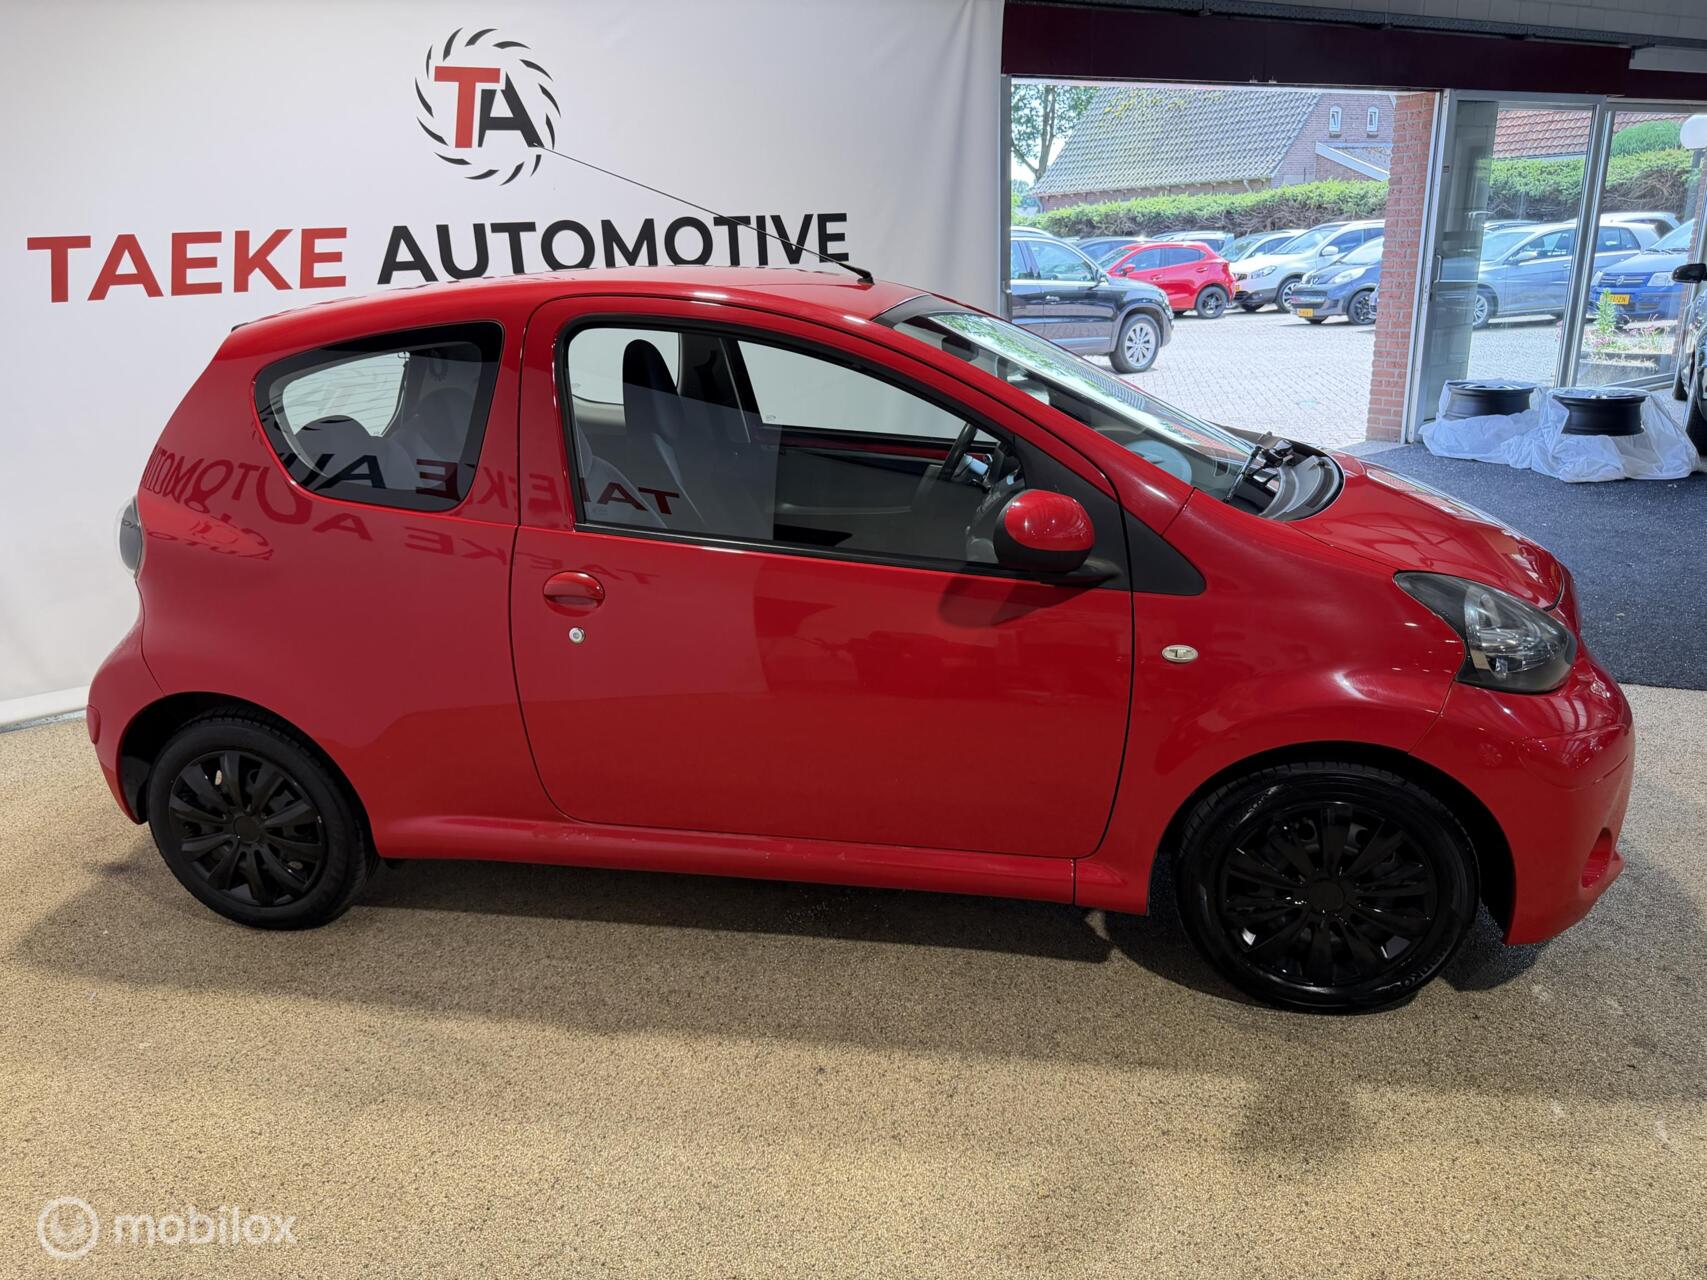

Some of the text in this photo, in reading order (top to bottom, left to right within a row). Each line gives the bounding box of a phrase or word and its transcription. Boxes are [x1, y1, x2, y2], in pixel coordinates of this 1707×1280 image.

[434, 66, 545, 148] TA
[27, 213, 849, 303] TAEKE AUTOMOTIVE
